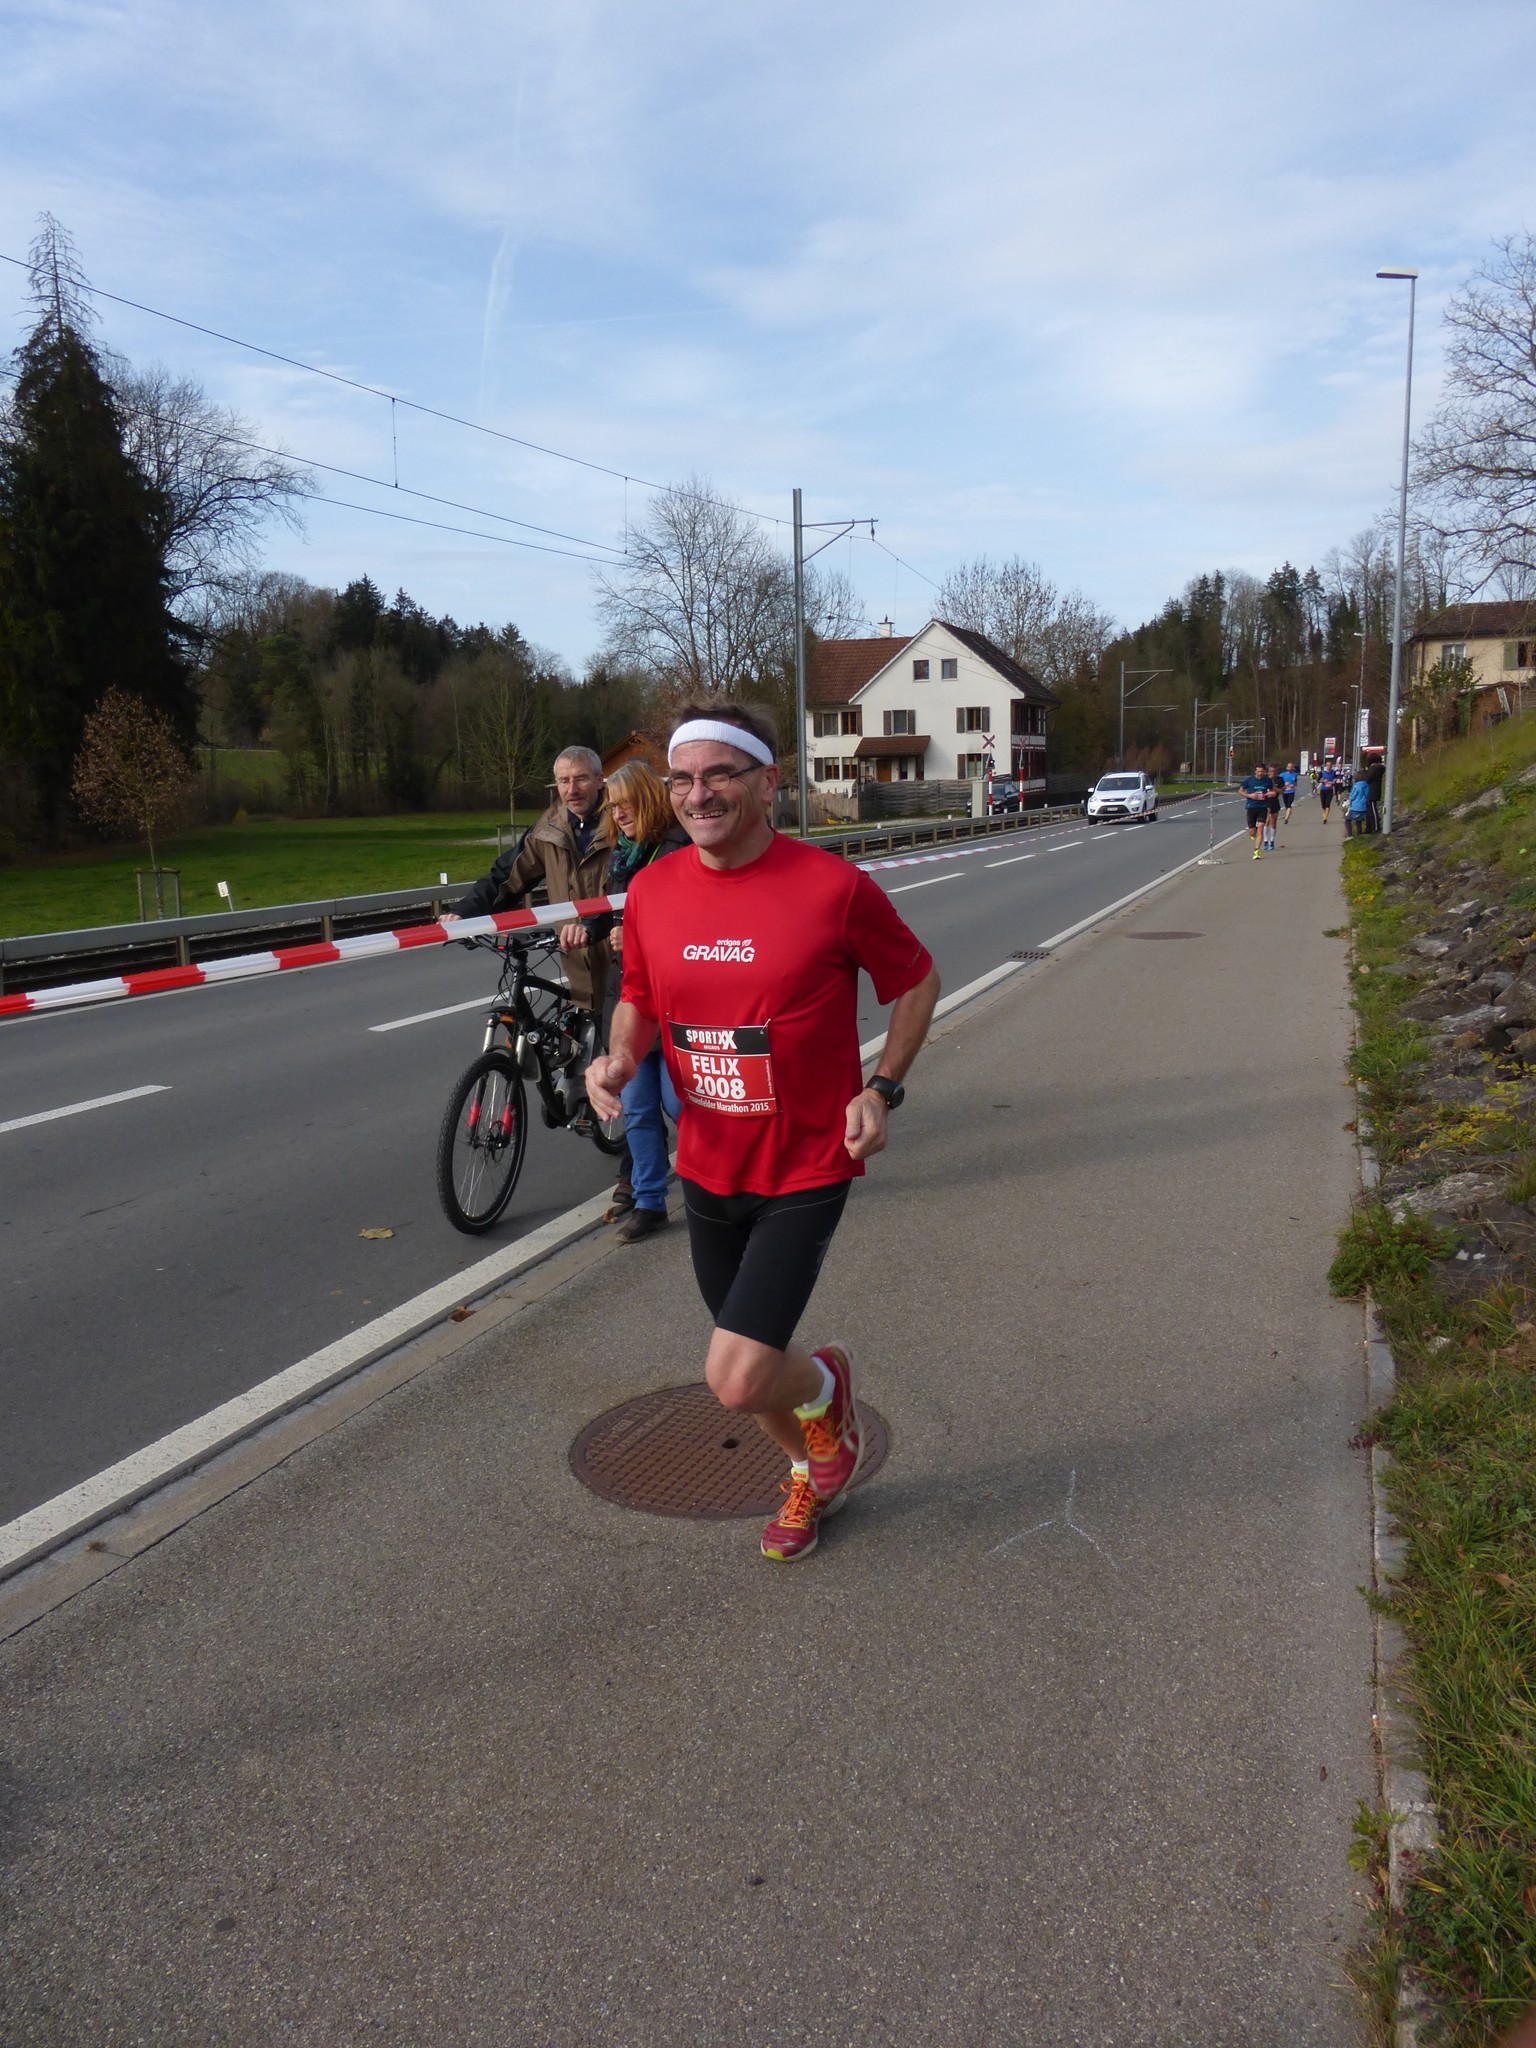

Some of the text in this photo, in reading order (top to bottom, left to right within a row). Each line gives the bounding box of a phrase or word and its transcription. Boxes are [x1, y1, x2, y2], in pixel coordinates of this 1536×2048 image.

[716, 938, 741, 947] erdgas
[683, 944, 756, 963] GRAVAG
[686, 1029, 738, 1050] SPORTXX
[690, 1054, 741, 1076] FELIX
[692, 1073, 747, 1100] 2008
[716, 1101, 749, 1113] Marathon
